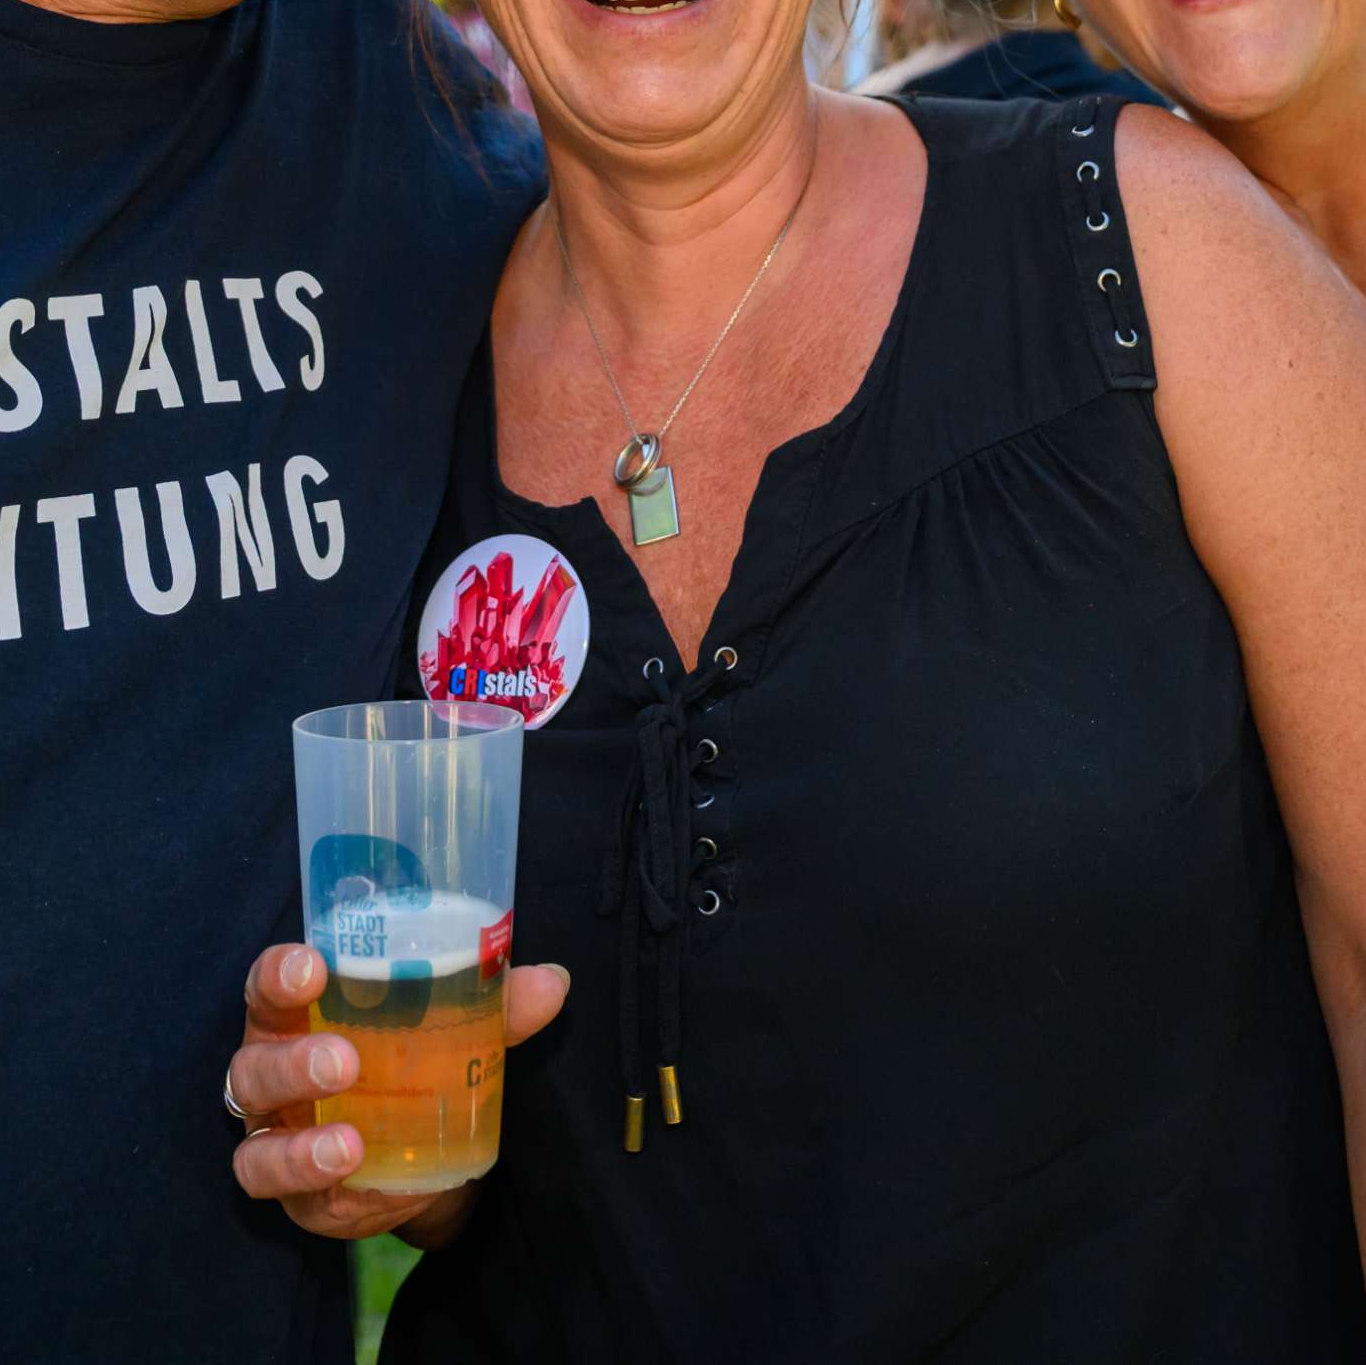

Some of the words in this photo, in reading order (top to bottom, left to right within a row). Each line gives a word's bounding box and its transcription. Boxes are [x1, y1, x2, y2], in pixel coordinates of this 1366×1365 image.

[449, 666, 537, 698] CRIstals
[337, 912, 387, 934] STADT
[338, 932, 388, 959] FEST
